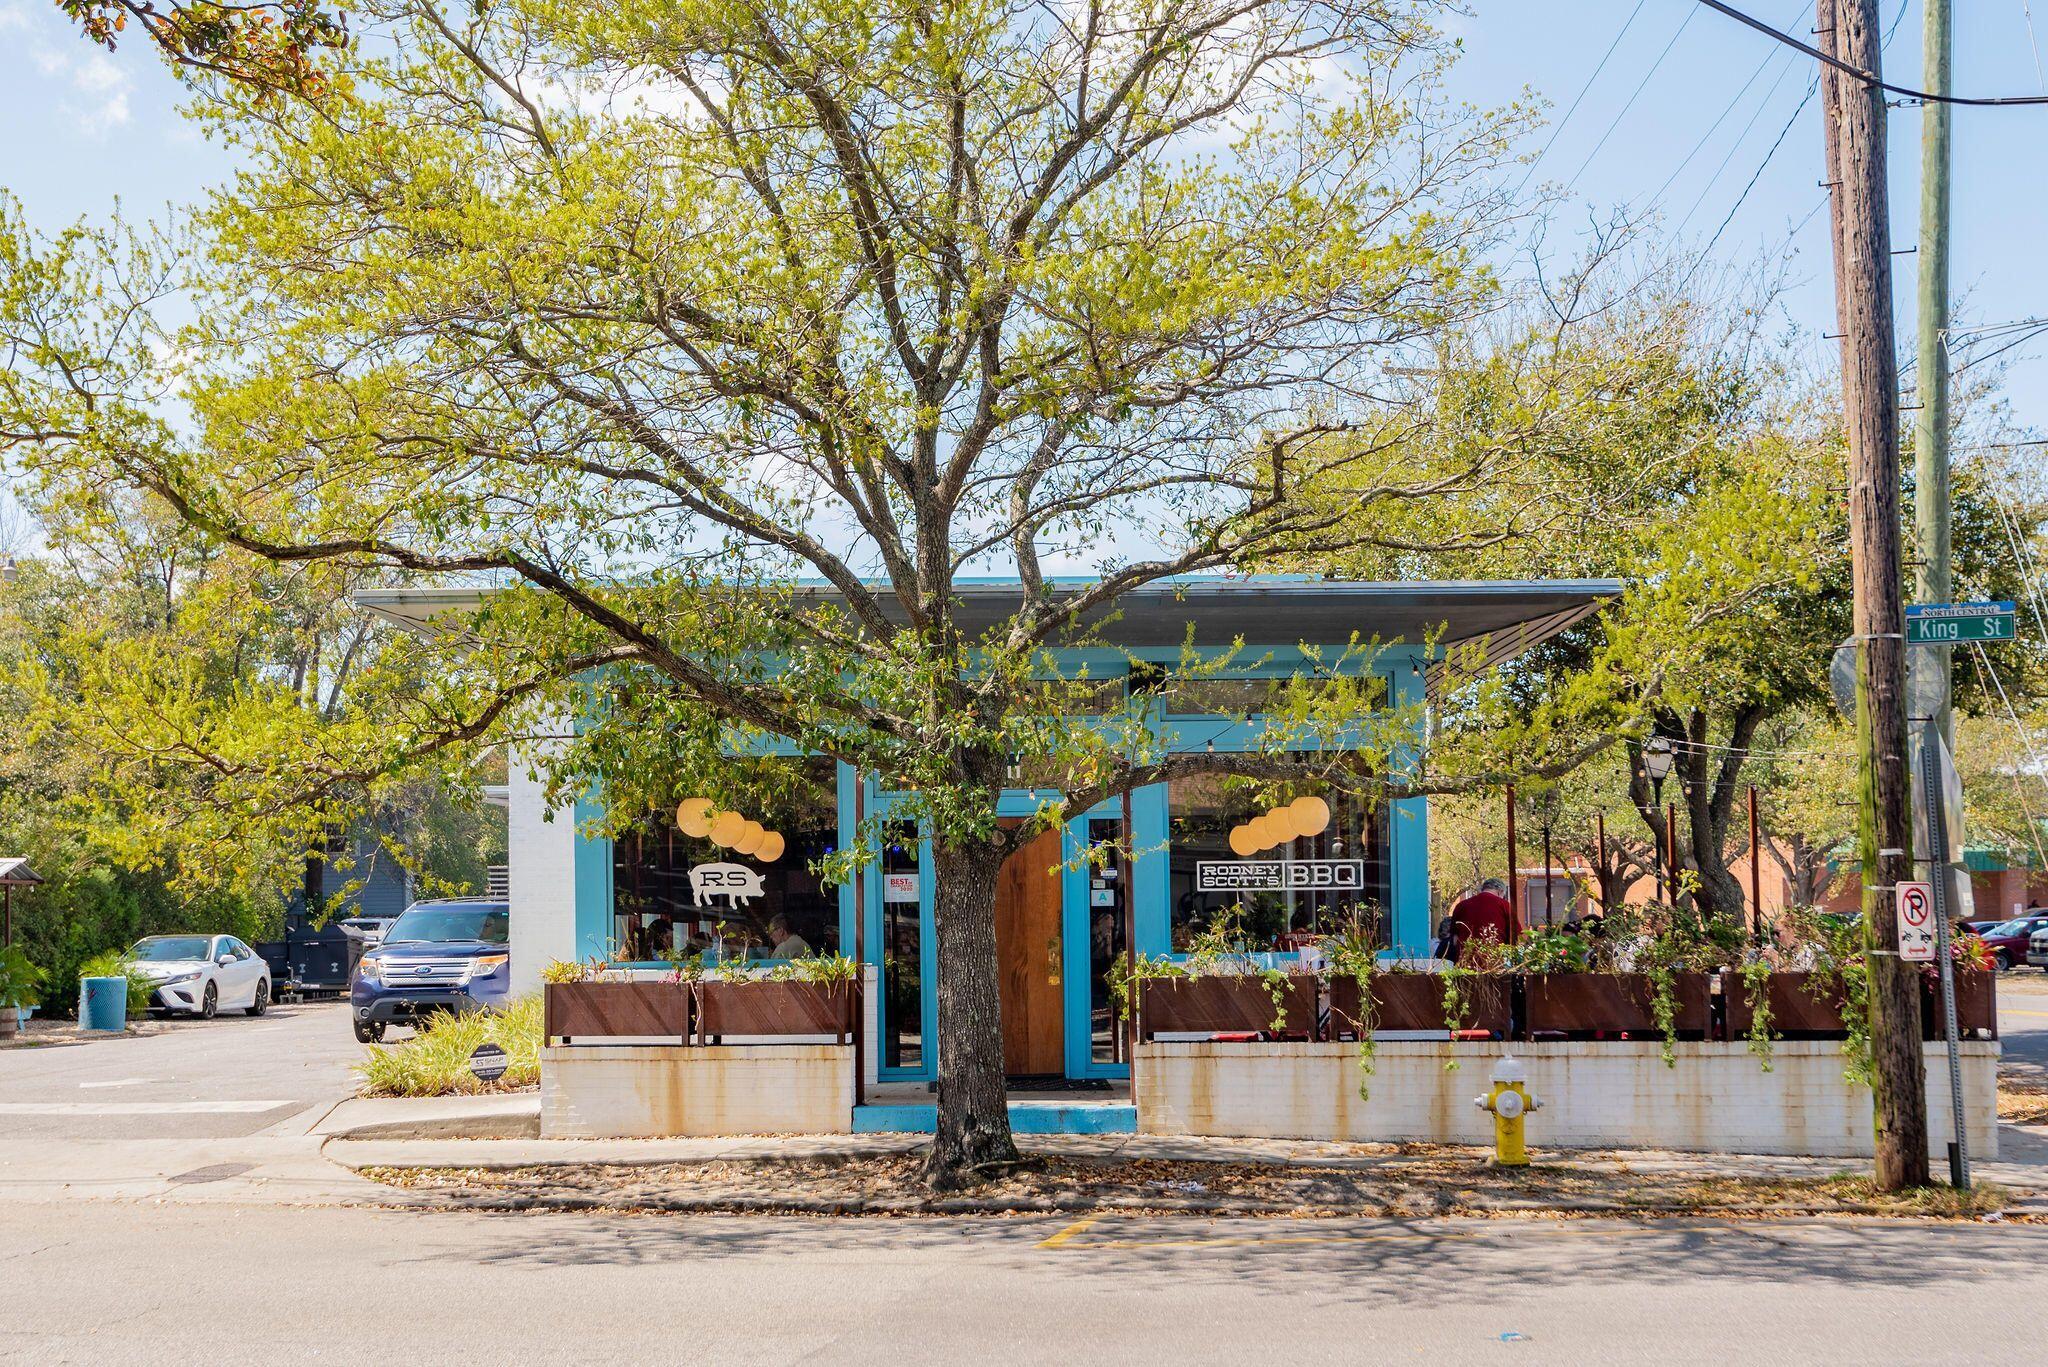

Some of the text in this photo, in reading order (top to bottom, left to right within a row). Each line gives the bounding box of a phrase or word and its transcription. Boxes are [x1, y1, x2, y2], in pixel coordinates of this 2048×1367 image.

[1924, 607, 1995, 617] NORTH CENTRAL
[1920, 617, 2002, 640] King St
[1202, 865, 1280, 876] RODNEY
[1287, 864, 1357, 886] BBQ
[700, 871, 747, 887] RS
[1202, 876, 1280, 887] SCOTT'S
[1098, 892, 1108, 901] A
